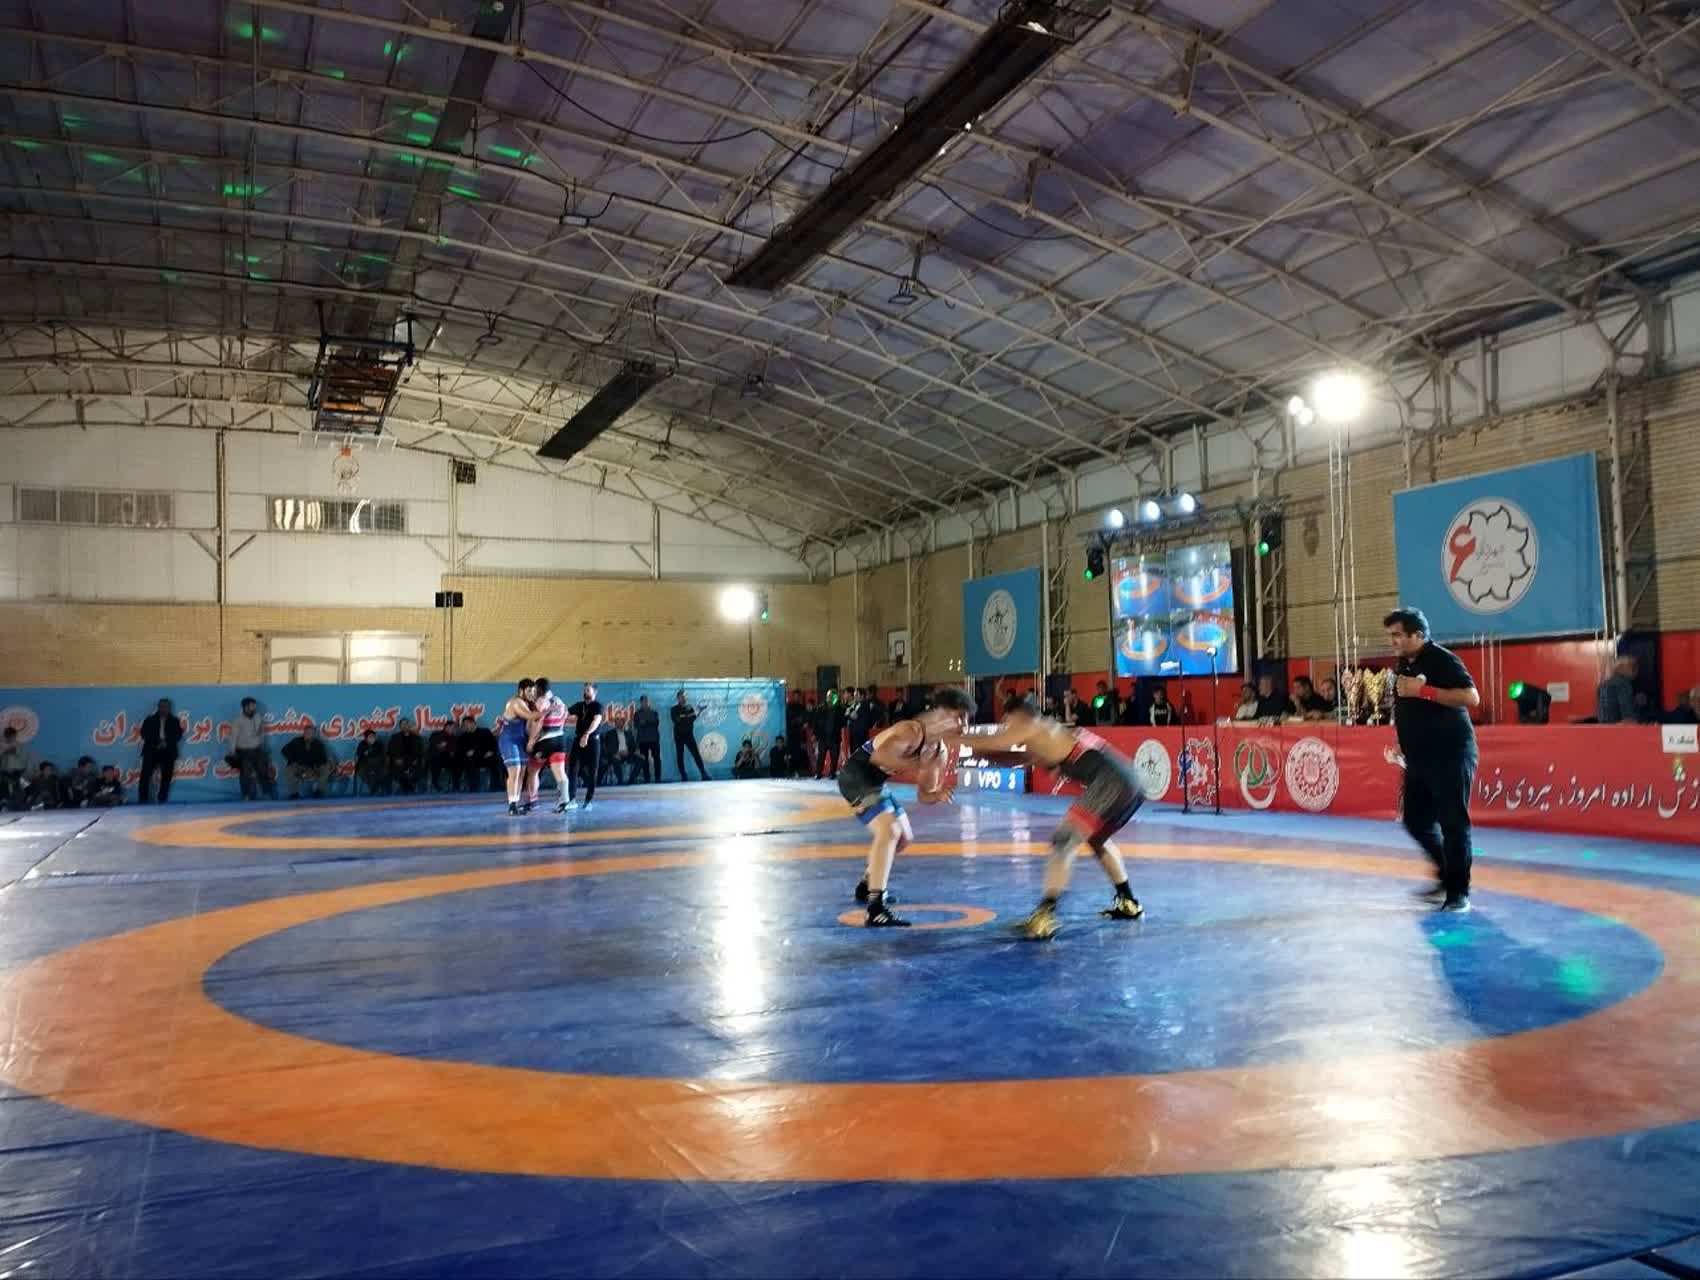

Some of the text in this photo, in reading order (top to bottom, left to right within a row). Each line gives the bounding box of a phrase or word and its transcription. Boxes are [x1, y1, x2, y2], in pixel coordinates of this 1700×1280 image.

[320, 704, 401, 740] کشوری
[1478, 766, 1504, 808] فردا
[1505, 762, 1555, 811] نیروی
[1611, 782, 1653, 809] اراده
